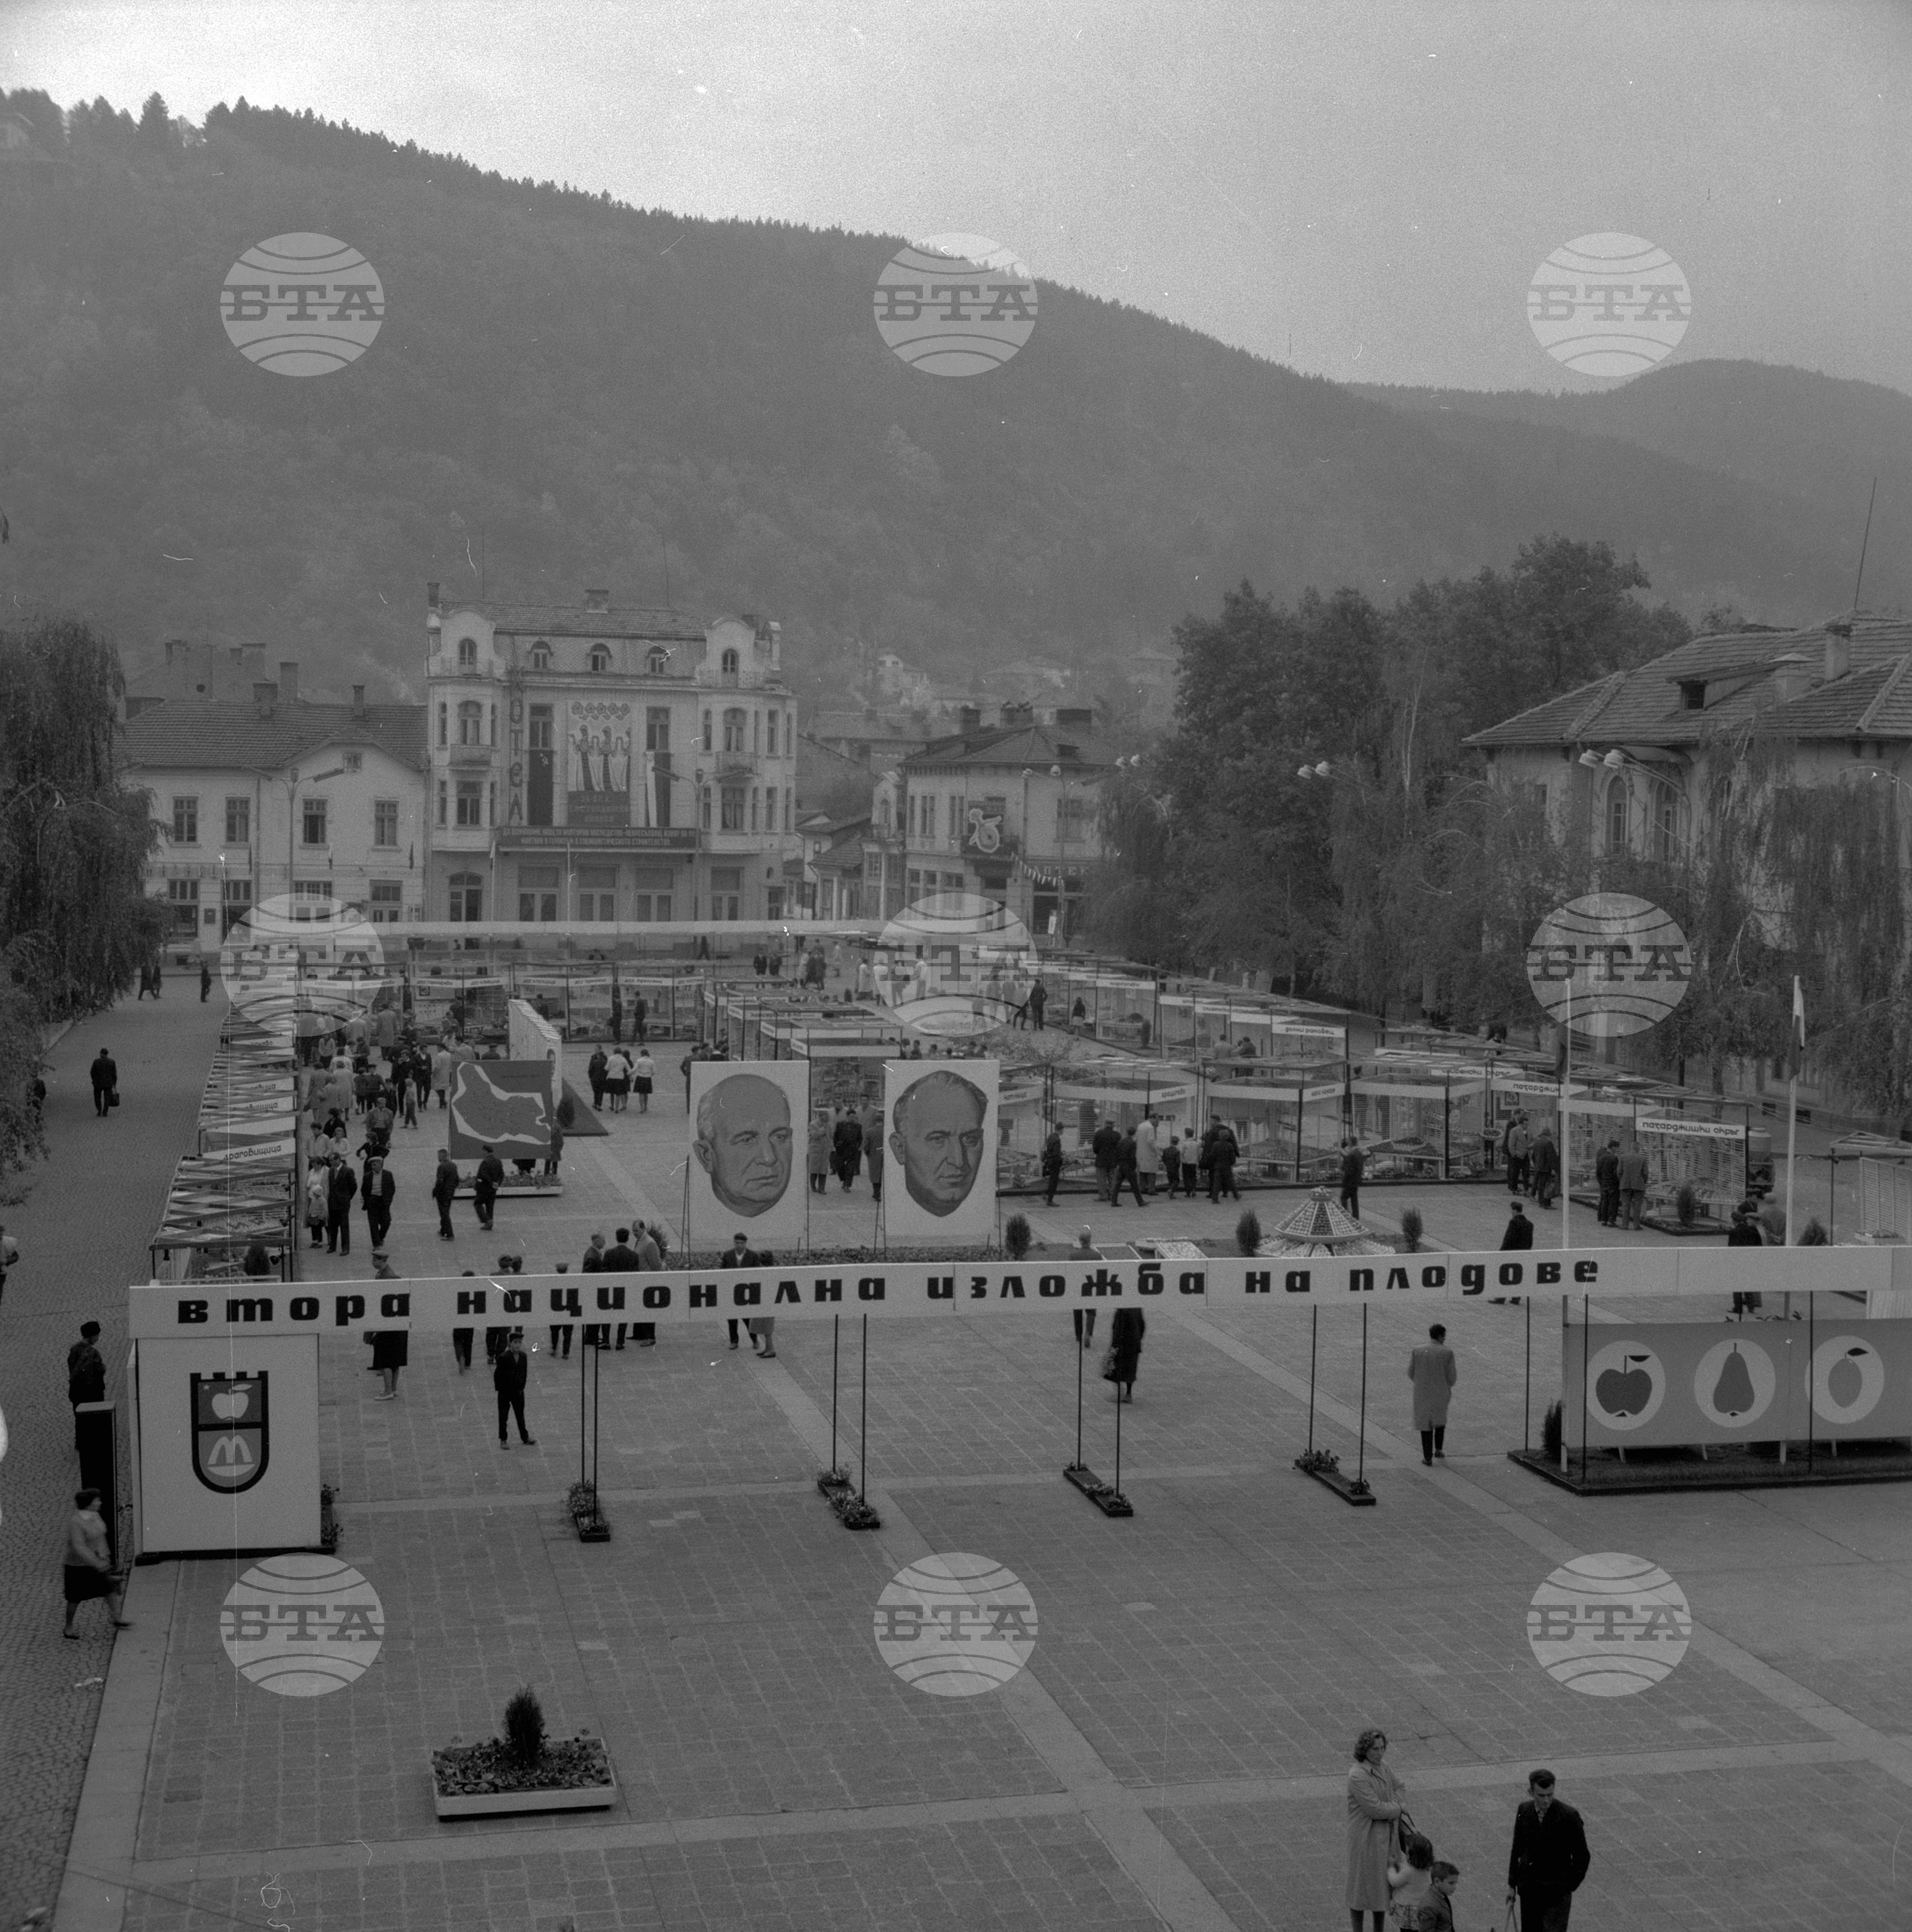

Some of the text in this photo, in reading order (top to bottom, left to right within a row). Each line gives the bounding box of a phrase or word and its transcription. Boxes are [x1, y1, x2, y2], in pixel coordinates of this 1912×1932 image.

[1643, 1122, 1711, 1132] пазарджишки
[177, 1260, 1598, 1327] втора национална изложба на плодове
